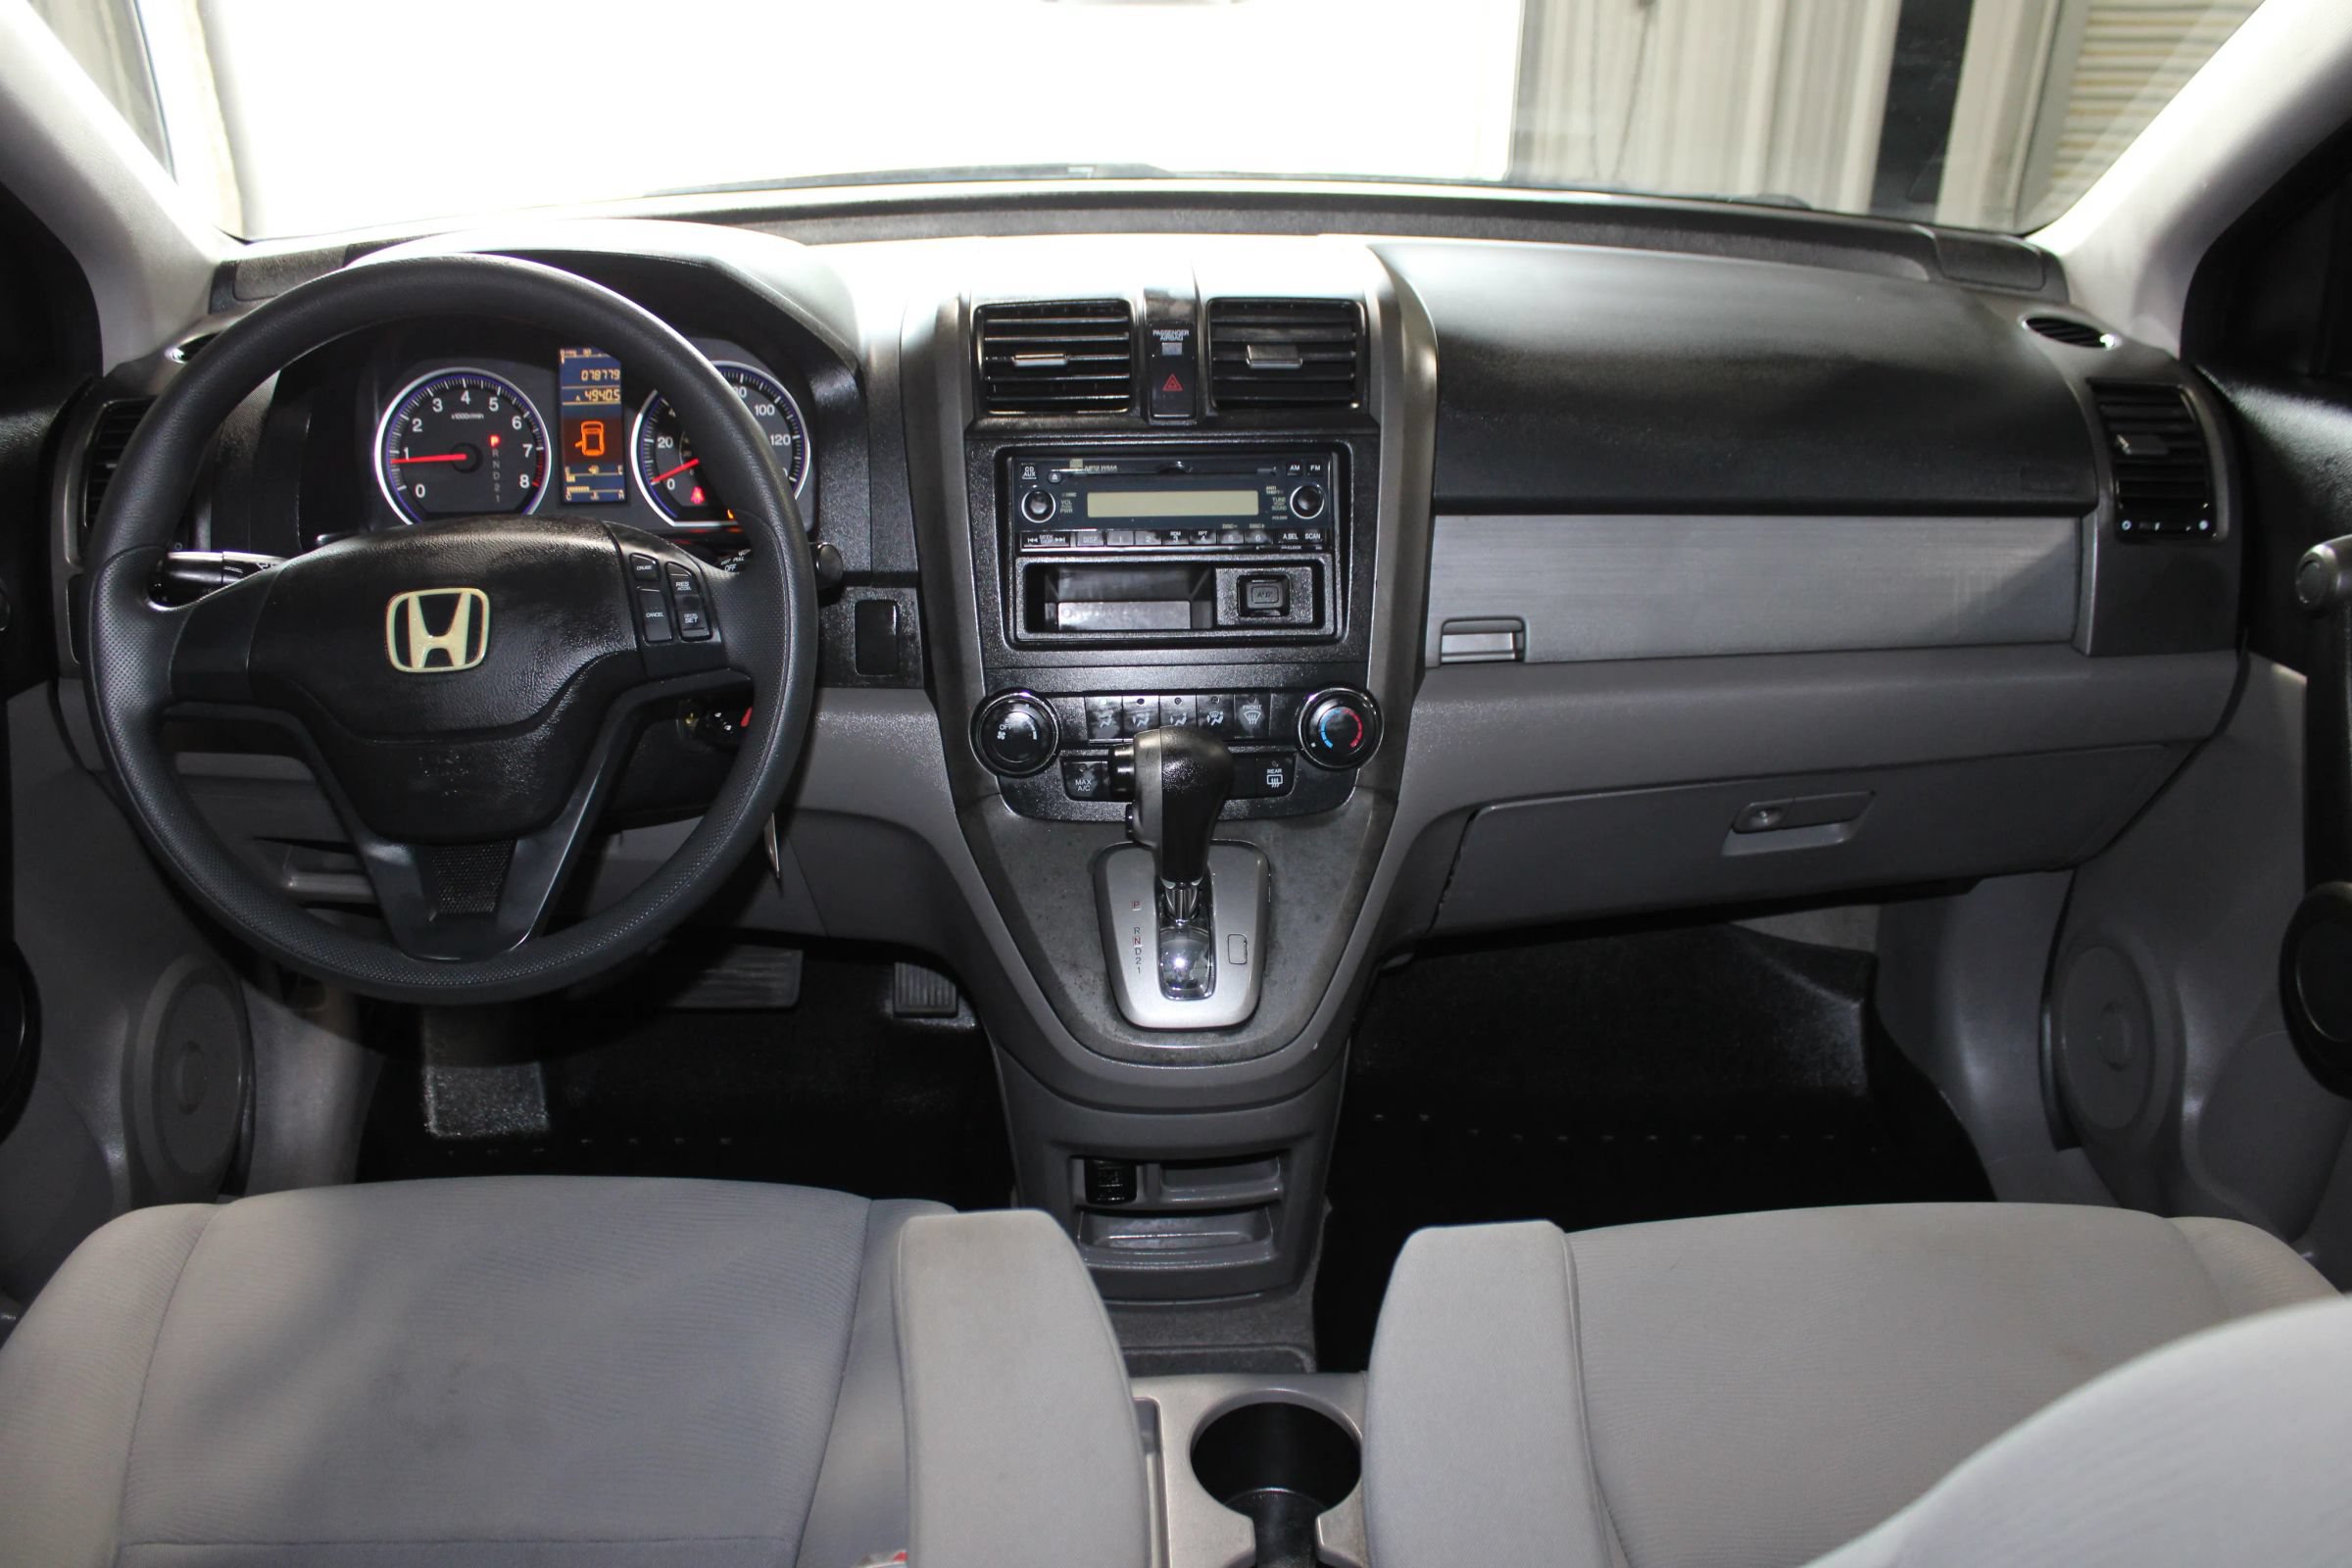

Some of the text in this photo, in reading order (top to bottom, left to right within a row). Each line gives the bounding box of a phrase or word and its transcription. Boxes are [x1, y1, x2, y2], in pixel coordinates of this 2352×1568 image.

[581, 369, 620, 381] 078779
[461, 390, 470, 404] 4
[433, 398, 443, 412] 3
[489, 398, 499, 412] 5
[755, 404, 775, 416] 100
[413, 418, 422, 432] 2
[512, 416, 521, 429] 6
[490, 435, 500, 447] P
[658, 437, 674, 449] 20
[770, 435, 791, 447] 120
[404, 448, 410, 461] 1
[523, 444, 532, 458] 7
[519, 474, 529, 488] 8
[666, 478, 675, 491] 0
[416, 484, 425, 498] 0
